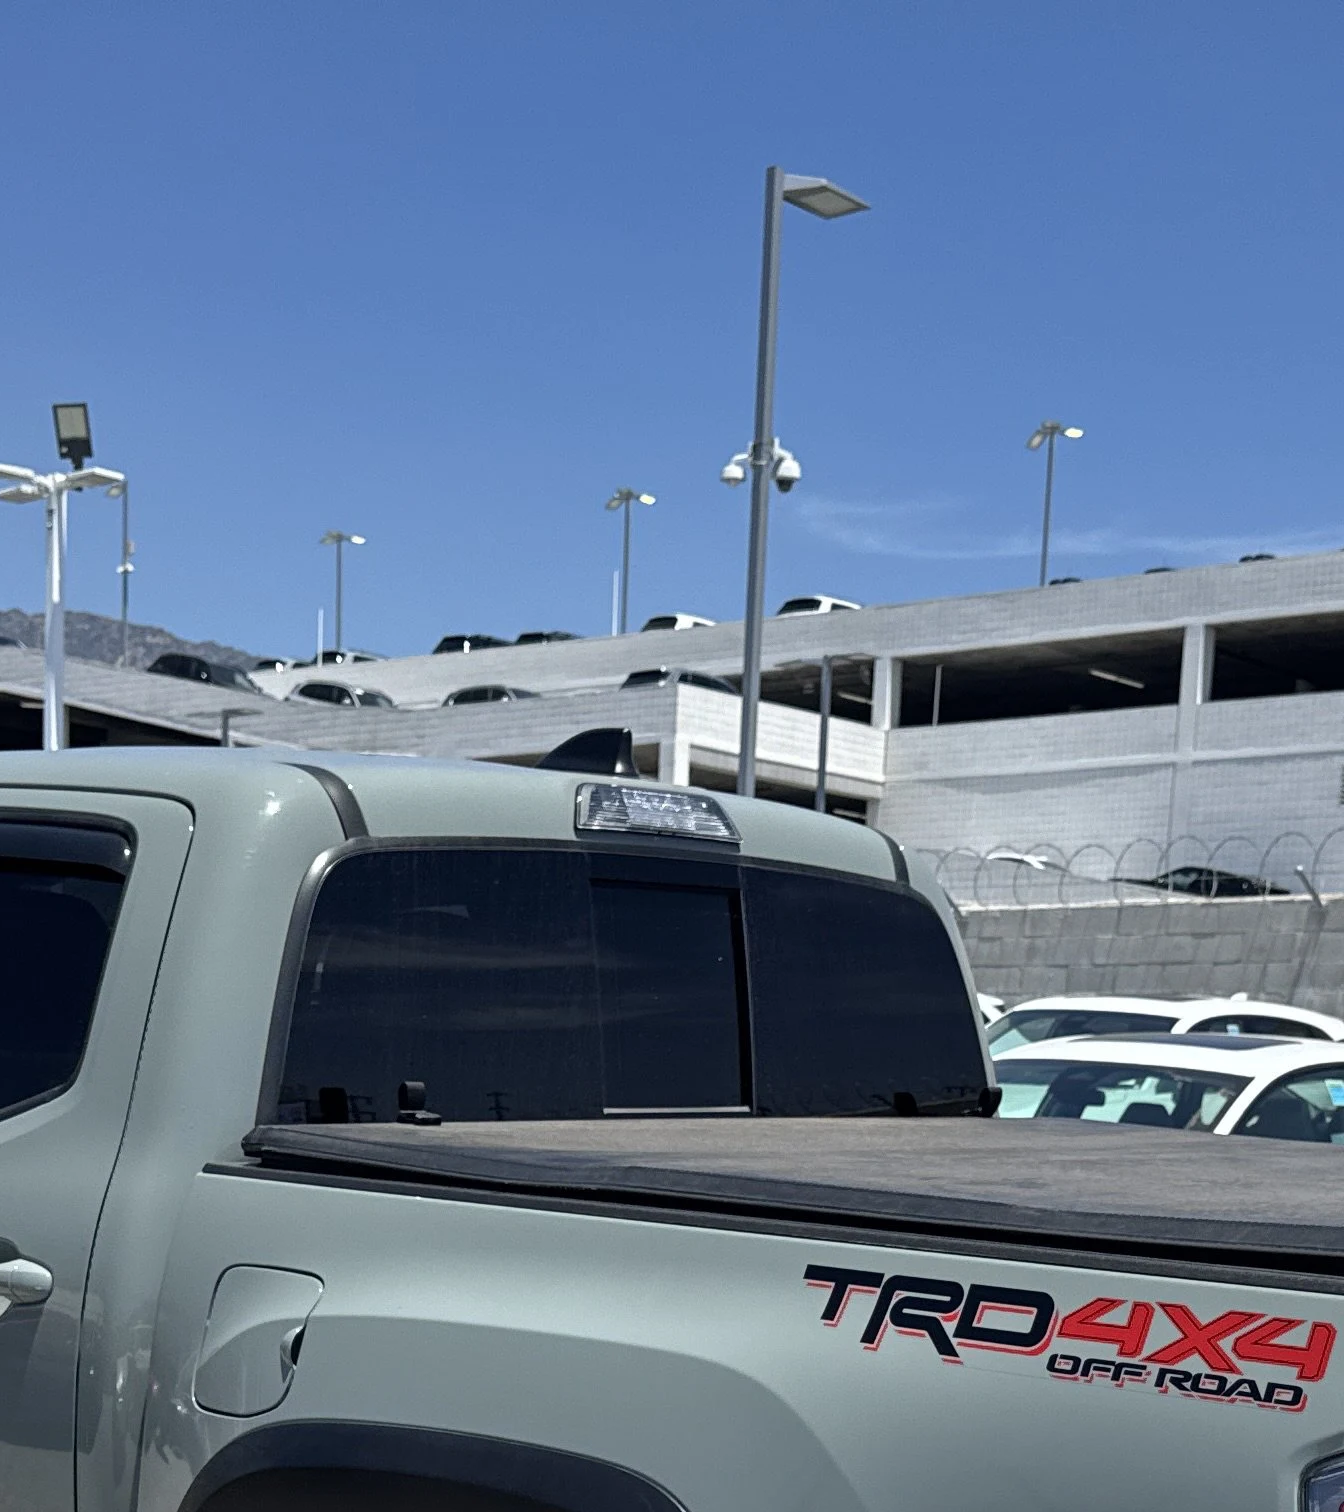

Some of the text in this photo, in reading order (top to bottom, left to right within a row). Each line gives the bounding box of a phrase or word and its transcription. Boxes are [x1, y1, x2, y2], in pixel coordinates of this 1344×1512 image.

[803, 1264, 1058, 1365] TRD
[1045, 1353, 1308, 1413] OFF ROAD
